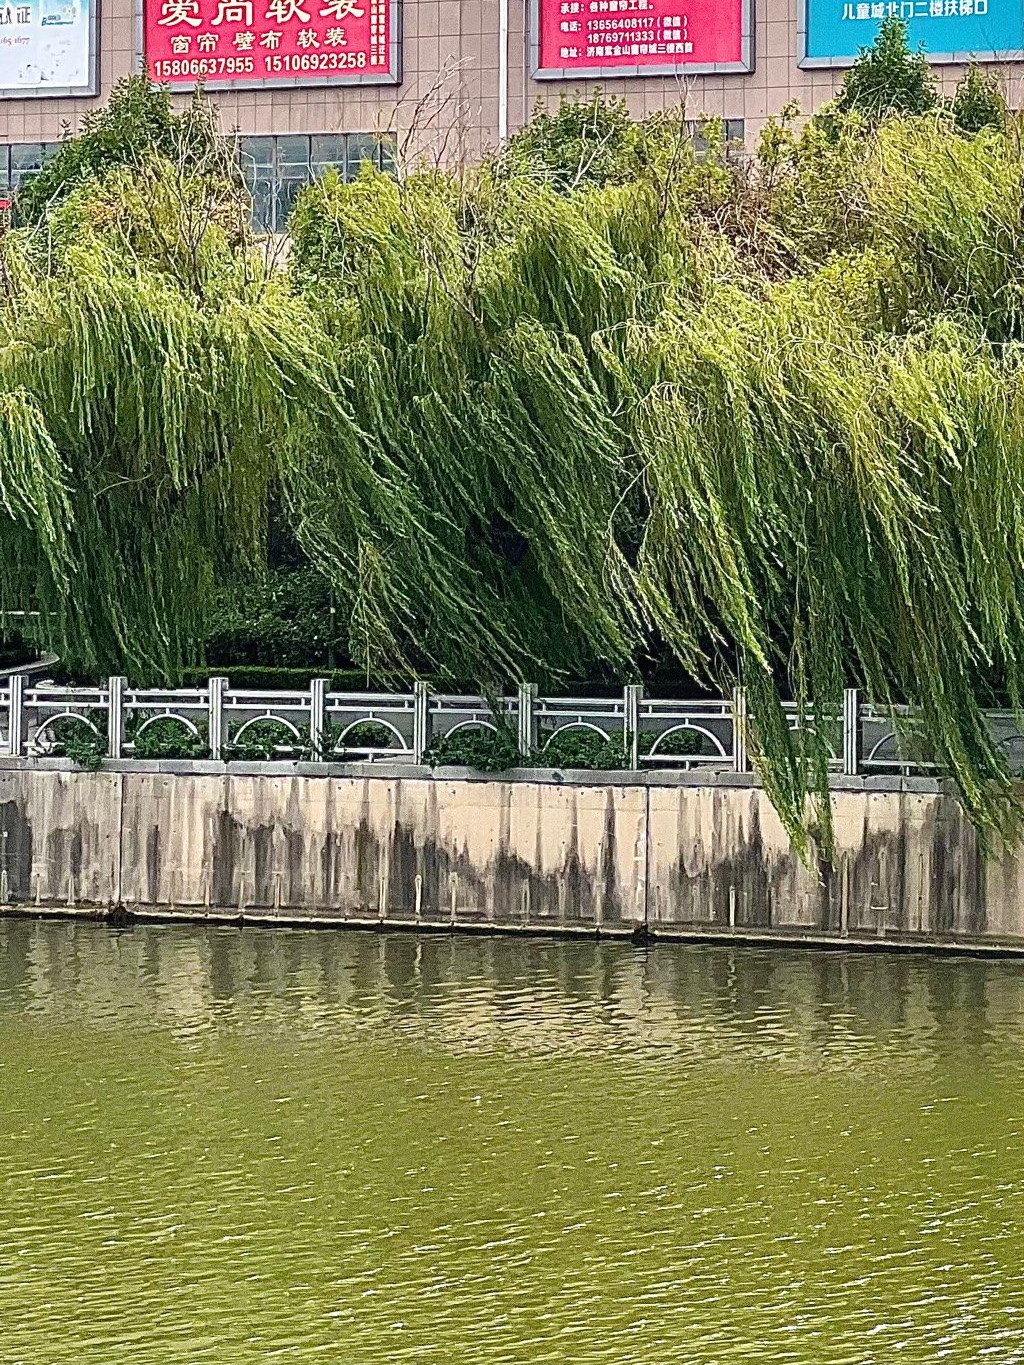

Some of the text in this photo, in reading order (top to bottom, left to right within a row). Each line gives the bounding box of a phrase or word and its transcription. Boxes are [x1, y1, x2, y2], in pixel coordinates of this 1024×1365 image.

[170, 27, 348, 54] 窗帘 壁布 软装
[154, 52, 366, 76] 15806637955 15106923258
